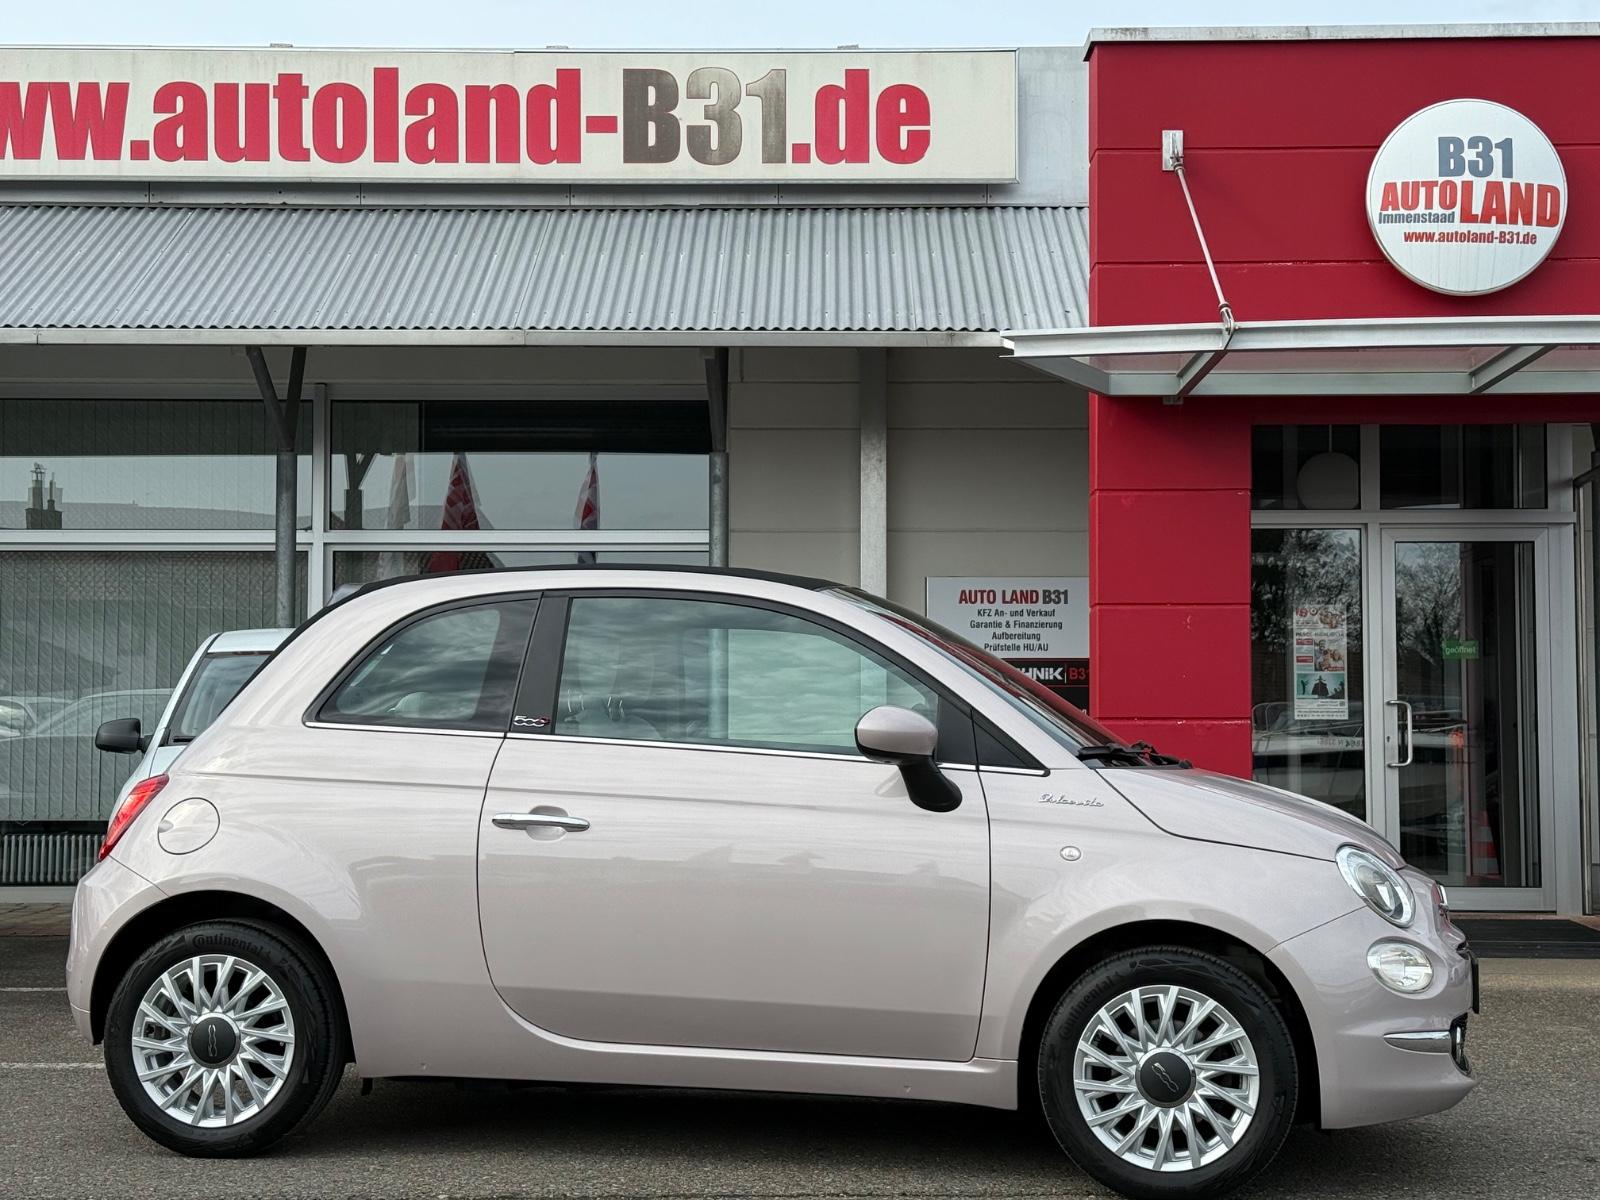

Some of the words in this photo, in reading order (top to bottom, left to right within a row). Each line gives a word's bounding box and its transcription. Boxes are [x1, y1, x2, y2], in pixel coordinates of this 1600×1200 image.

[1438, 135, 1514, 178] B31
[1378, 211, 1455, 224] Immenstaad
[1404, 230, 1537, 245] www.autoland-B31.de
[958, 589, 997, 605] AUTO
[1002, 589, 1040, 605] LAND
[1042, 589, 1069, 605] B31
[977, 609, 992, 617] KFZ
[994, 609, 1008, 617] An-
[1010, 609, 1024, 617] und
[1026, 609, 1056, 617] Verkauf
[970, 620, 1003, 629] Garantie
[1005, 620, 1011, 629] &
[1013, 620, 1063, 630] Finanzierung
[992, 631, 1041, 641] Aufbereitung
[984, 643, 1021, 651] Prüfstelle
[1023, 643, 1049, 652] HU/AU
[1069, 667, 1089, 680] B3
[192, 932, 264, 956] Continental
